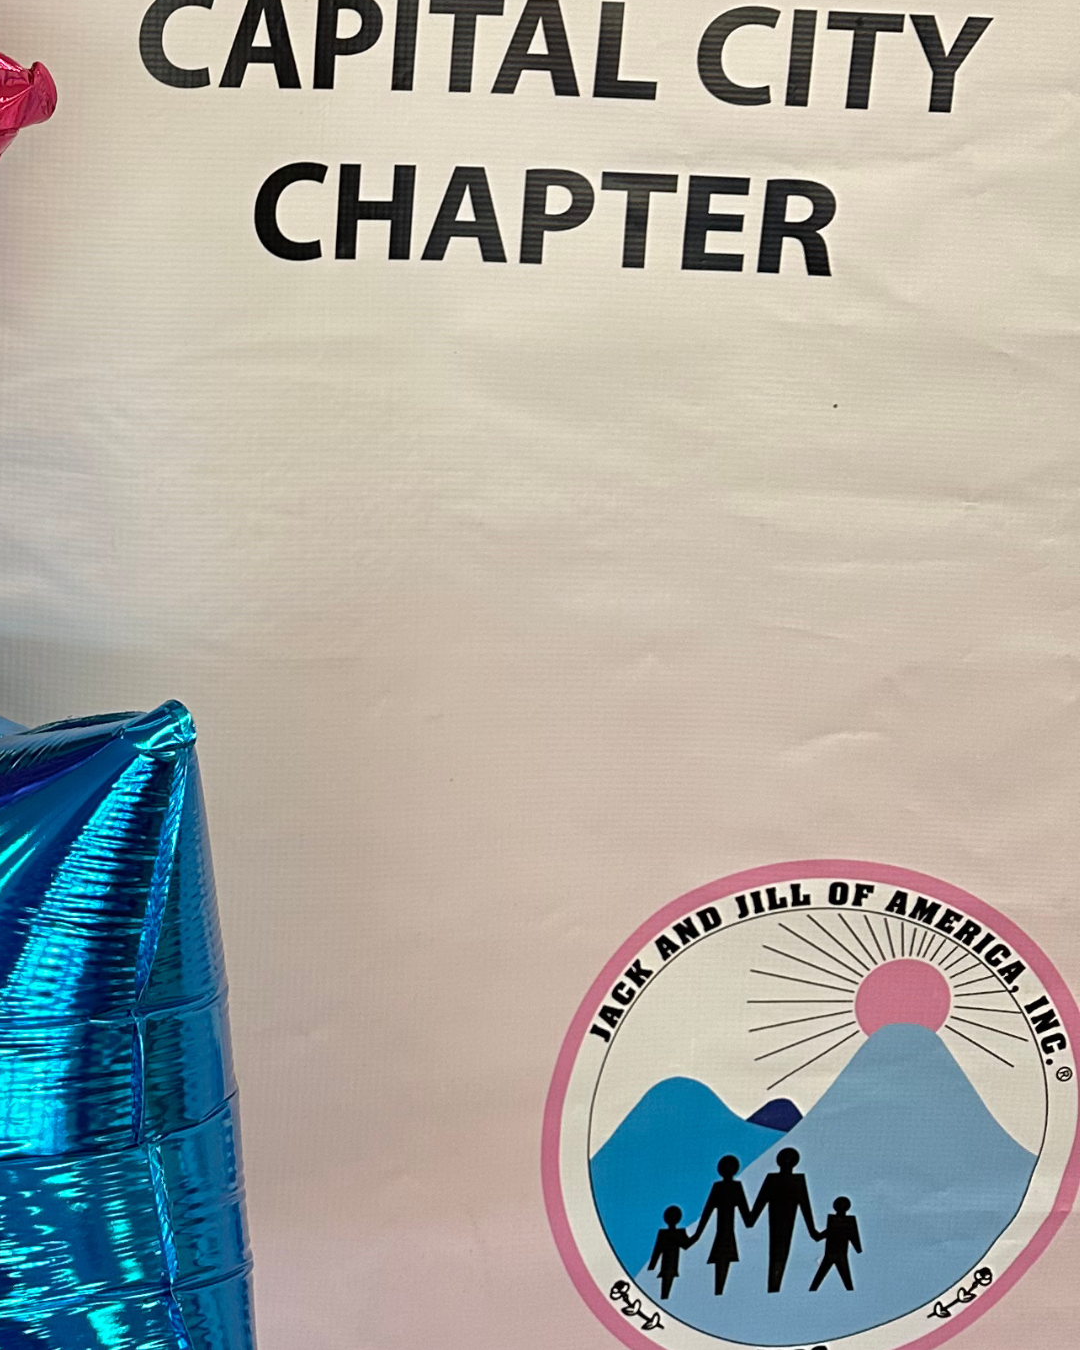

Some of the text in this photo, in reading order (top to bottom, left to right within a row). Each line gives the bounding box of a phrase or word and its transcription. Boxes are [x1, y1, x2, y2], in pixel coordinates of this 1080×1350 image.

[697, 5, 994, 113] CITY
[254, 161, 837, 277] CHAPTER
[590, 962, 653, 1043] JACK
[654, 907, 723, 961] AND
[735, 883, 811, 919] JILL
[828, 881, 875, 906] OF
[884, 890, 1027, 994] AMERICA,
